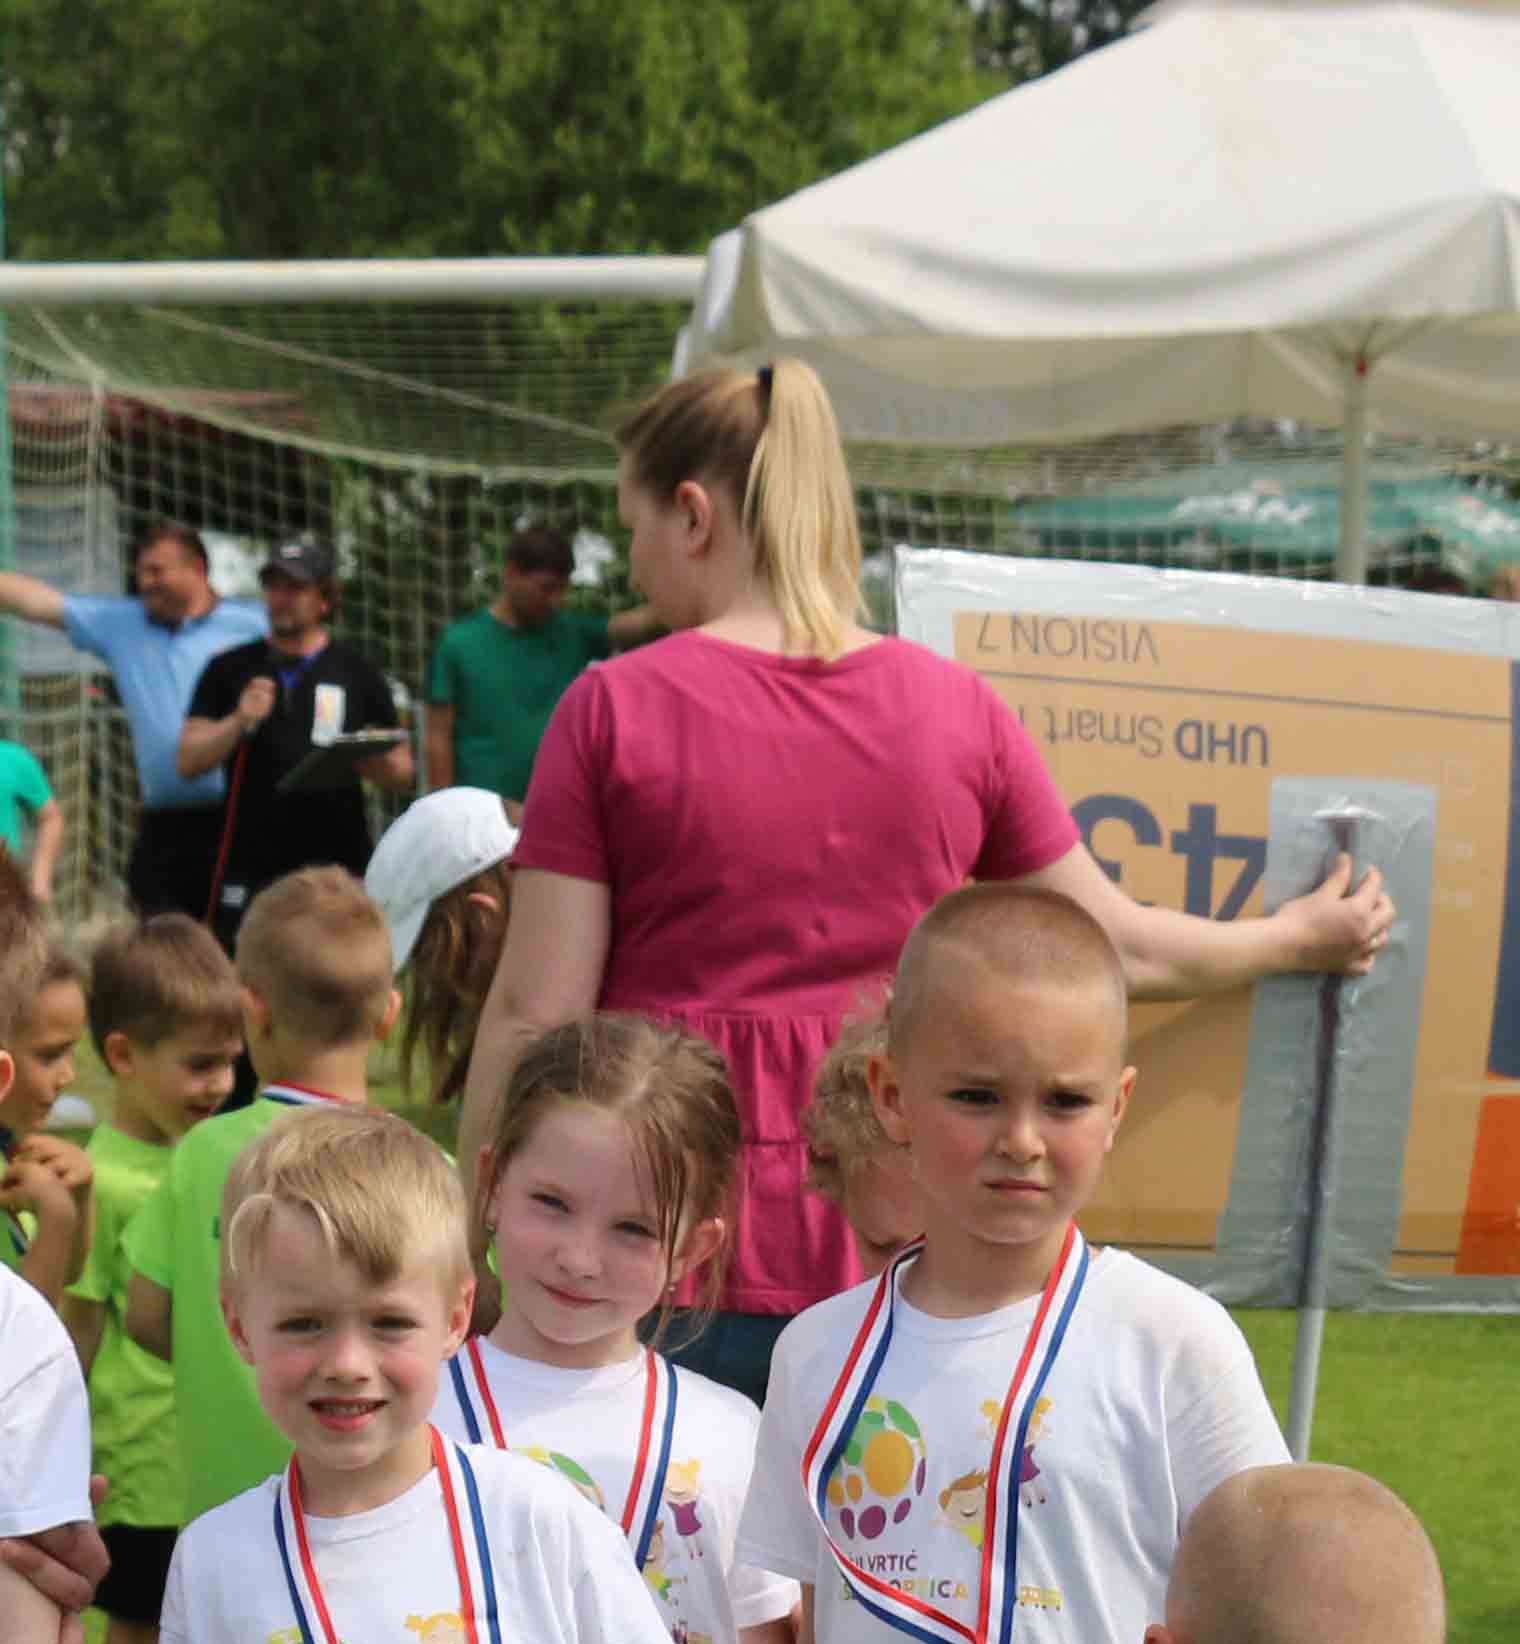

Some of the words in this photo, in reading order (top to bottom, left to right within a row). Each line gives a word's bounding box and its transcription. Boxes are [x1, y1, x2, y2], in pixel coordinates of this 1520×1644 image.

[976, 612, 1001, 652] 7
[1009, 613, 1160, 665] VISION
[1043, 705, 1164, 759] Smart
[1172, 719, 1270, 767] UHD
